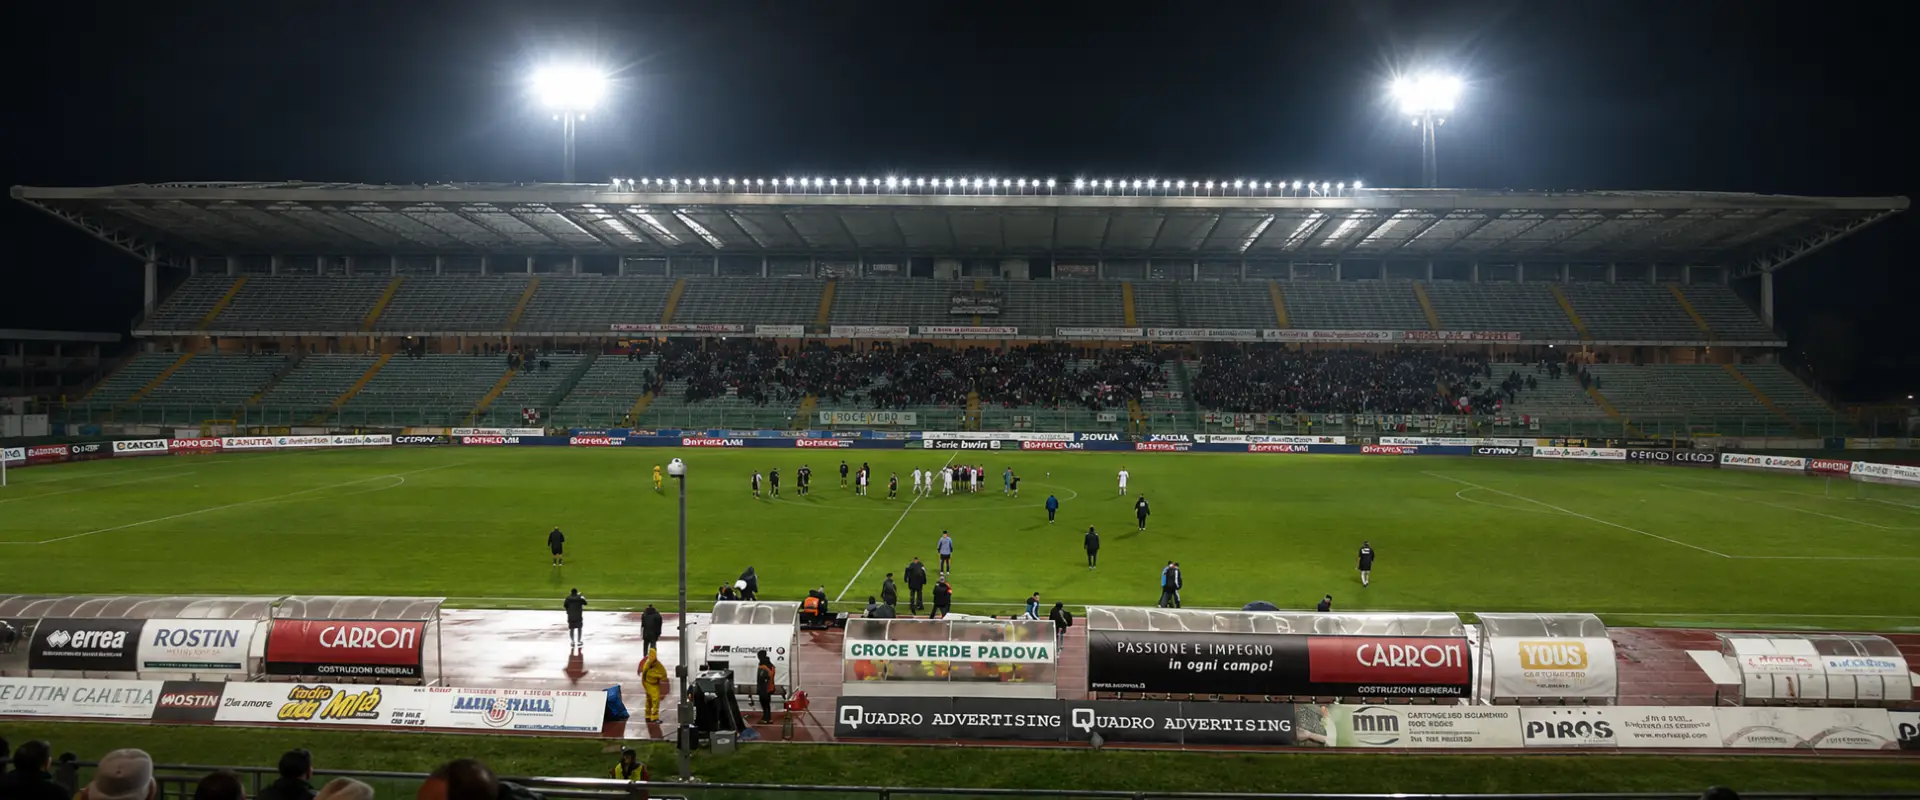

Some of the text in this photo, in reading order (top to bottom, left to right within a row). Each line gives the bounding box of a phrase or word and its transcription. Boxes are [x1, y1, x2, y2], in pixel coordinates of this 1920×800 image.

[936, 439, 988, 449] Serie bwin
[71, 630, 126, 649] errea
[153, 628, 239, 648] ROSTIN
[319, 625, 416, 649] CARRON
[851, 643, 1049, 660] CROCE VERDE PADOVA
[1117, 642, 1273, 656] PASSIONE E IMPEGNO
[1356, 643, 1462, 668] CARRON
[1523, 644, 1582, 666] YOUS
[318, 666, 414, 675] COSTRUZIONI GENERALI
[1168, 658, 1274, 674] in ogni campo!
[1358, 686, 1461, 695] COSTRUZIONI GENERALI
[840, 705, 1061, 729] QUADRO ADVERTISING
[1072, 708, 1291, 733] QUADRO ADVERTISING
[1526, 721, 1614, 739] PIROS
